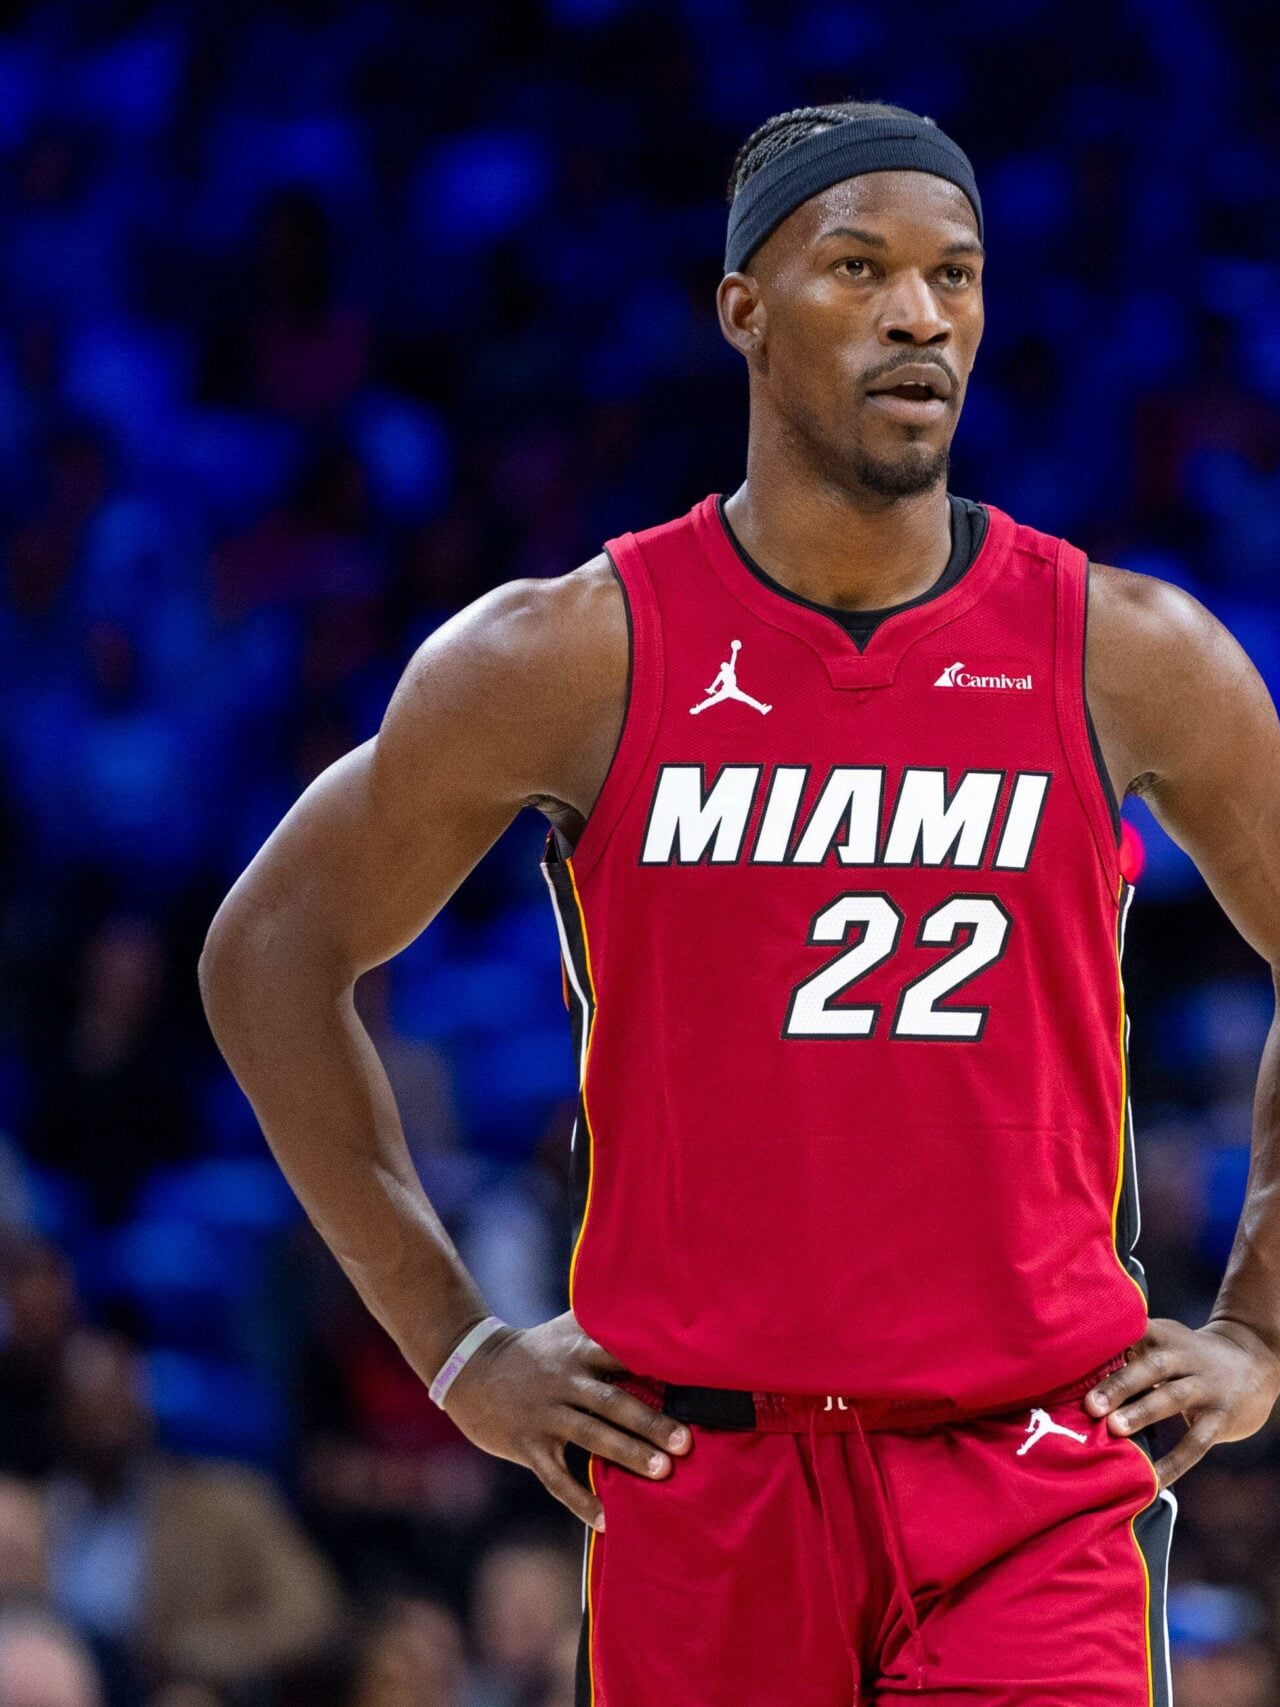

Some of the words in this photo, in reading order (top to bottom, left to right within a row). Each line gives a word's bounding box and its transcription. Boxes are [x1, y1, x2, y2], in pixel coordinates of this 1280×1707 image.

[956, 673, 1033, 690] Carnival
[638, 763, 1053, 873] MIAMI
[781, 890, 1014, 1042] 22
